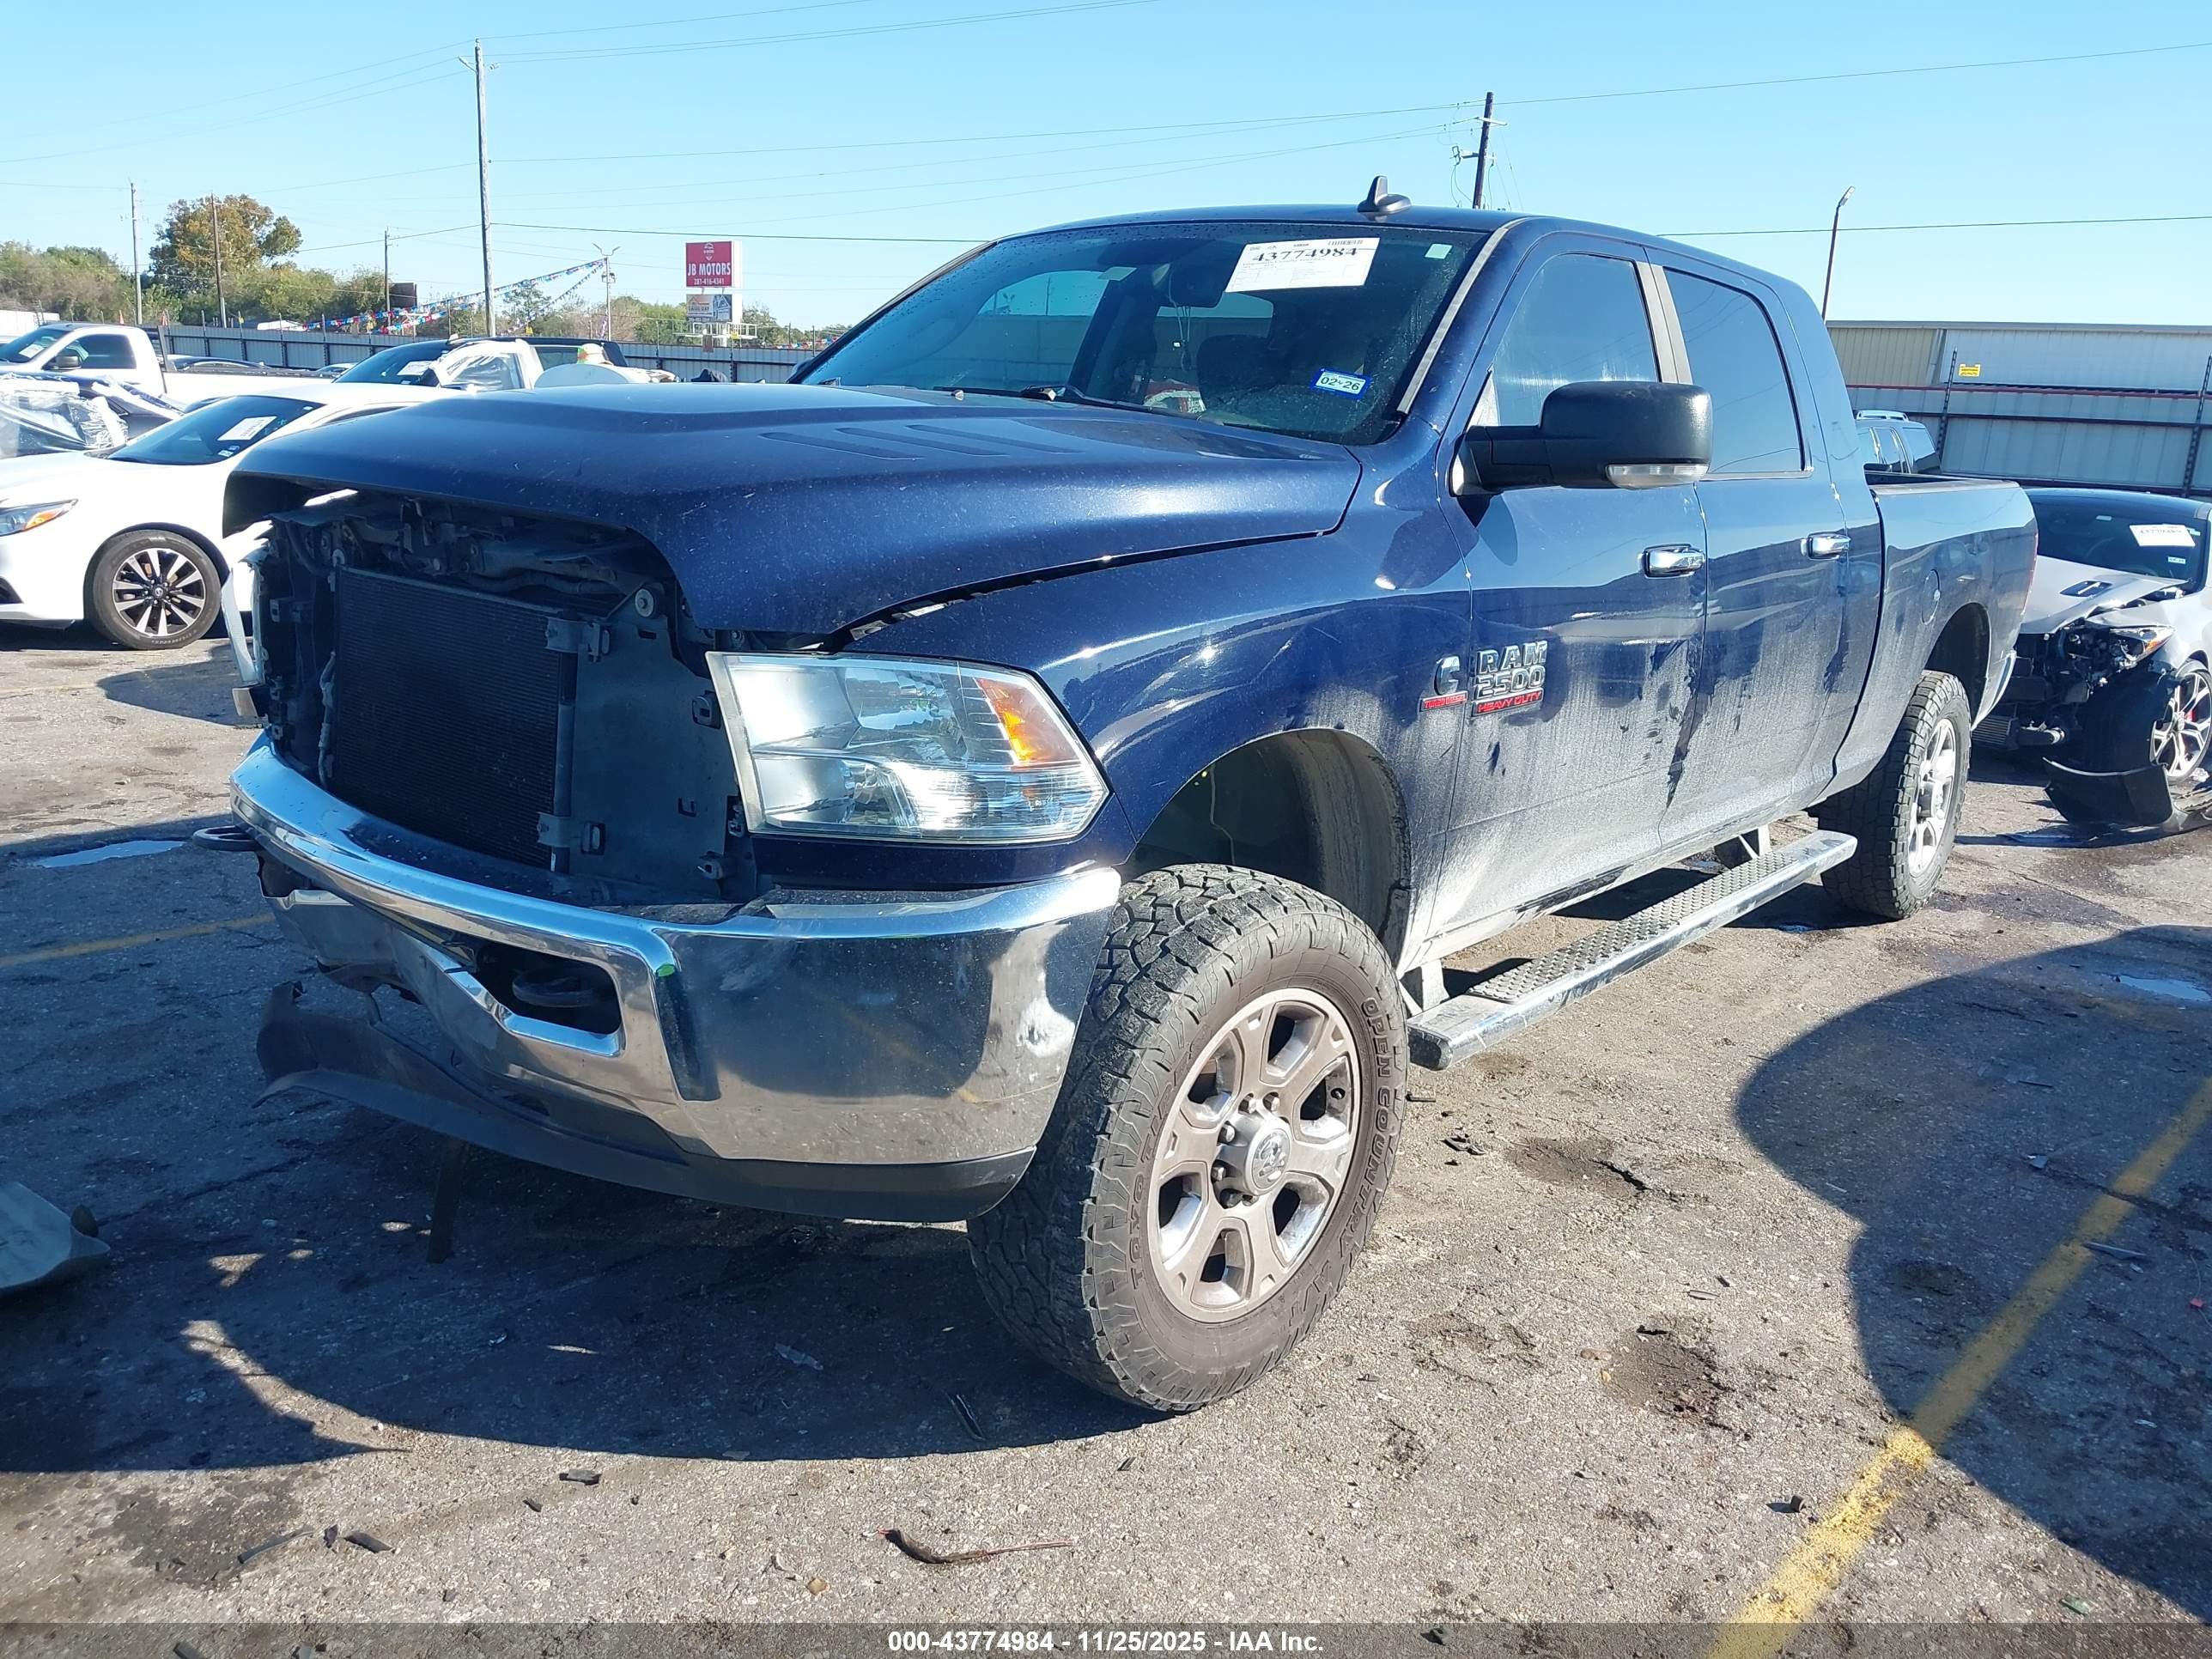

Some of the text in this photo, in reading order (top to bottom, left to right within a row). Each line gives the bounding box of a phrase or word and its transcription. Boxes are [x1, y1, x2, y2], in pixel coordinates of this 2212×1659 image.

[688, 262, 731, 276] JB MOTORS
[1252, 247, 1358, 262] 43774984
[1477, 640, 1547, 674] RAM
[1473, 665, 1546, 700] 2500
[1478, 690, 1542, 712] HEAVY DUTY
[1361, 997, 1391, 1077] OPEN
[1340, 1085, 1391, 1258] COUNTRY
[1129, 1173, 1145, 1290] TOYO
